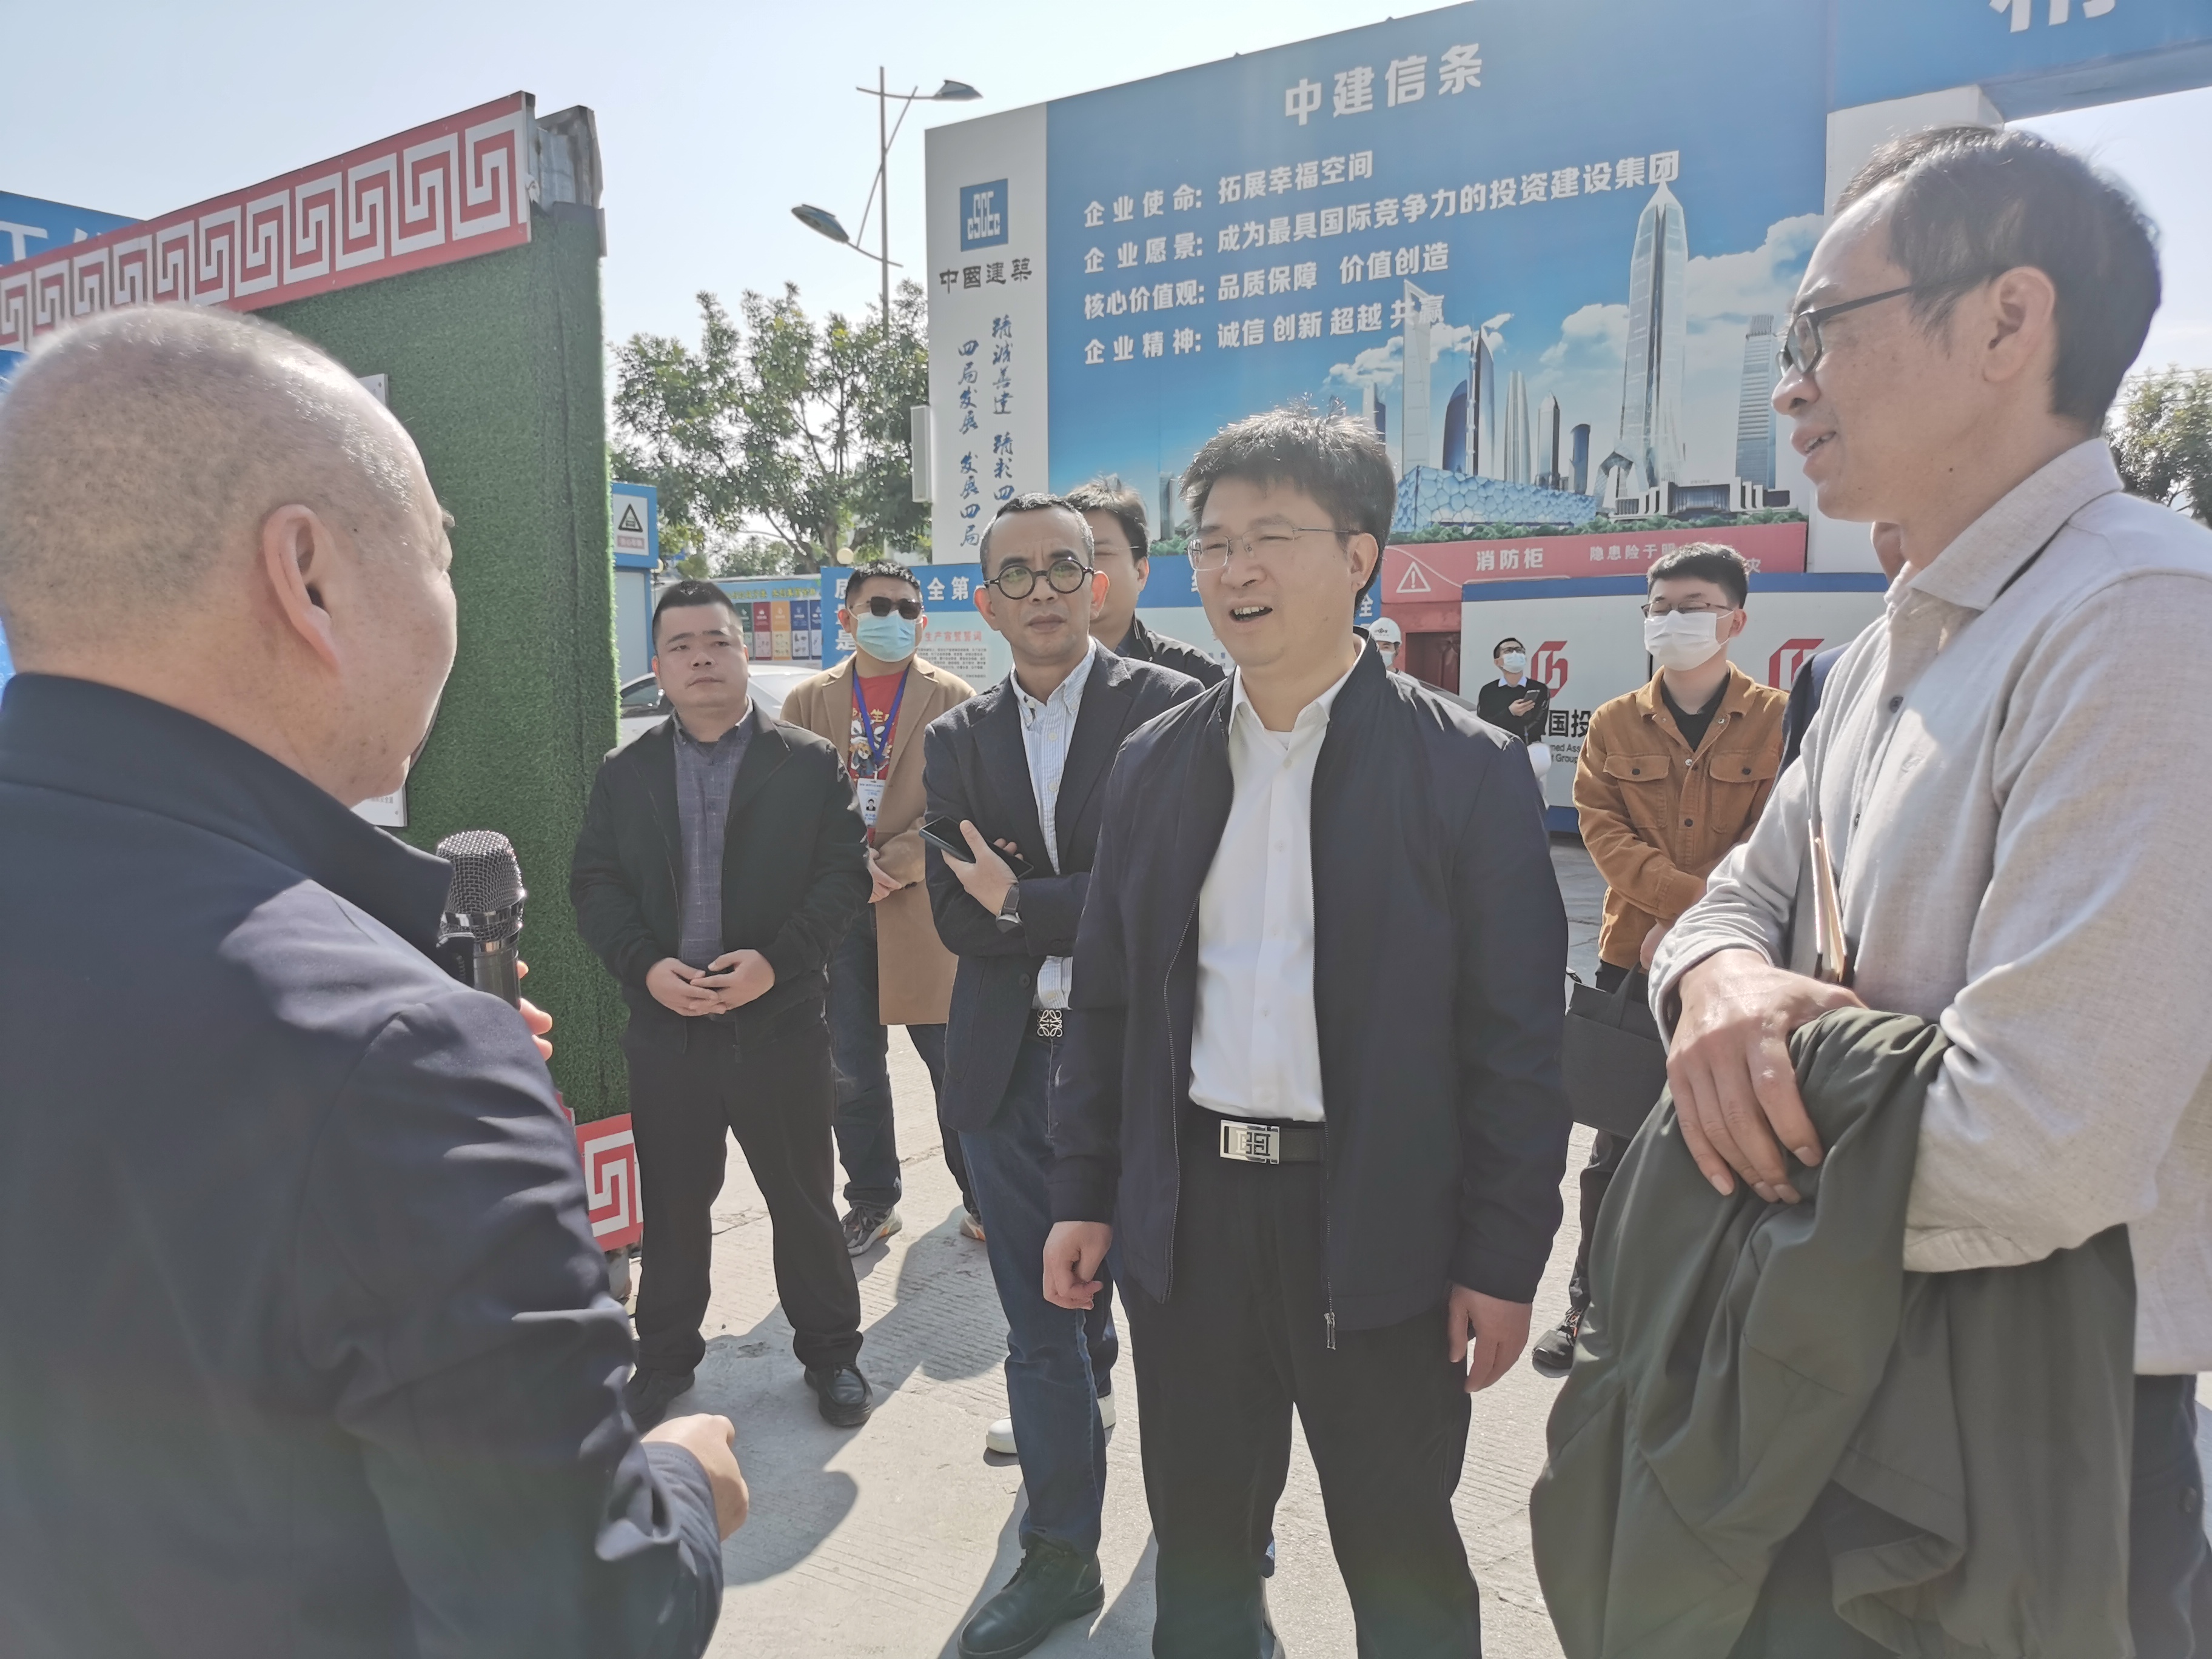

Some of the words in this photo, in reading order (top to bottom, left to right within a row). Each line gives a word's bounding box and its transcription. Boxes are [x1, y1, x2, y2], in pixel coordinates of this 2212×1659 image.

[1284, 43, 1483, 126] 中建信条
[1217, 149, 1680, 253] 成为最具国际竞争力的投资建设集团
[1218, 150, 1374, 205] 拓展幸福空间
[1218, 262, 1318, 301] 品质保障
[1339, 241, 1449, 285] 价值创造
[1218, 318, 1264, 350] 诚信
[1273, 311, 1322, 344] 创新
[1329, 301, 1382, 337] 超越
[1475, 548, 1544, 572] 消防柜
[919, 576, 970, 602] 全第
